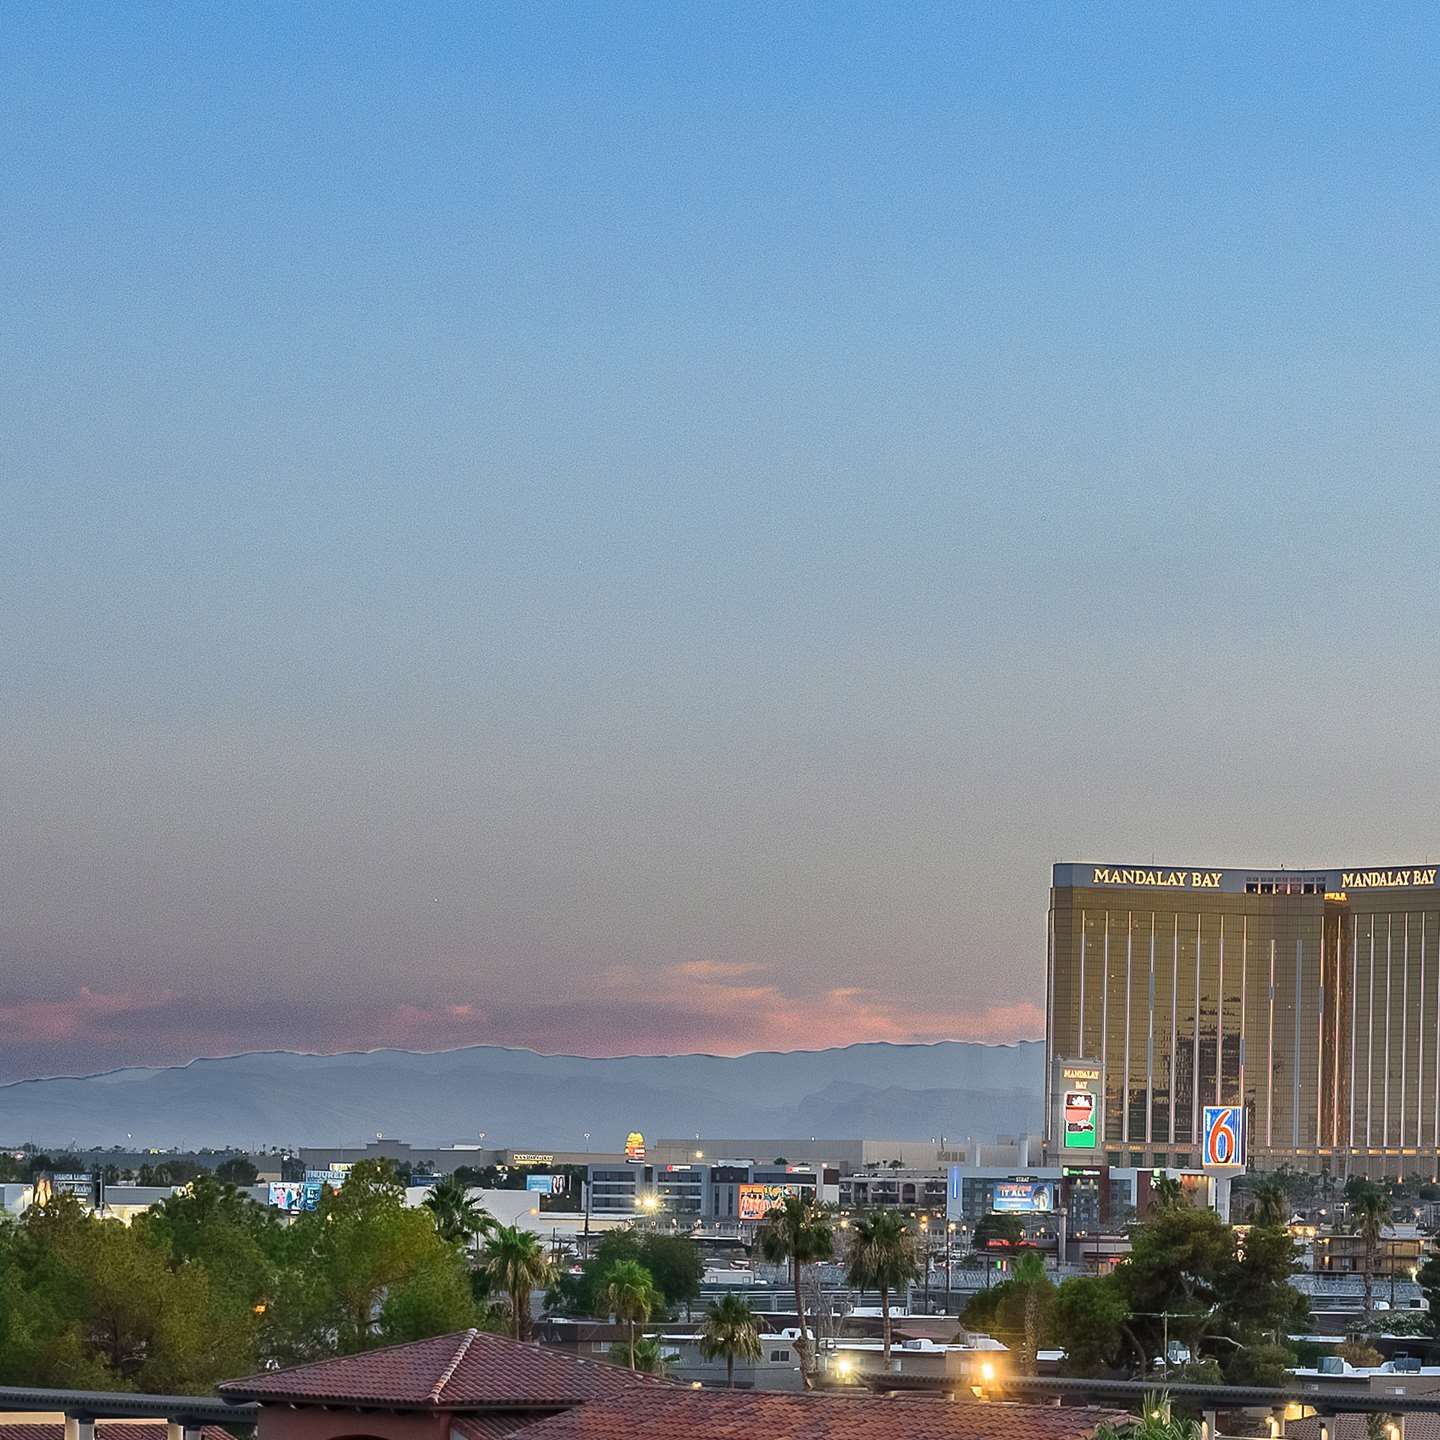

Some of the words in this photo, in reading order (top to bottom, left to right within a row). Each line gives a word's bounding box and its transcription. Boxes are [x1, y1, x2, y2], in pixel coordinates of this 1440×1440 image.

[1093, 869, 1188, 886] MANDALAY
[1191, 872, 1222, 887] BAY
[1341, 871, 1410, 888] MANDALAY
[1412, 870, 1437, 885] BAY
[1063, 1069, 1099, 1079] MANDALAY
[1075, 1081, 1088, 1089] BAY
[1208, 1109, 1235, 1165] 6
